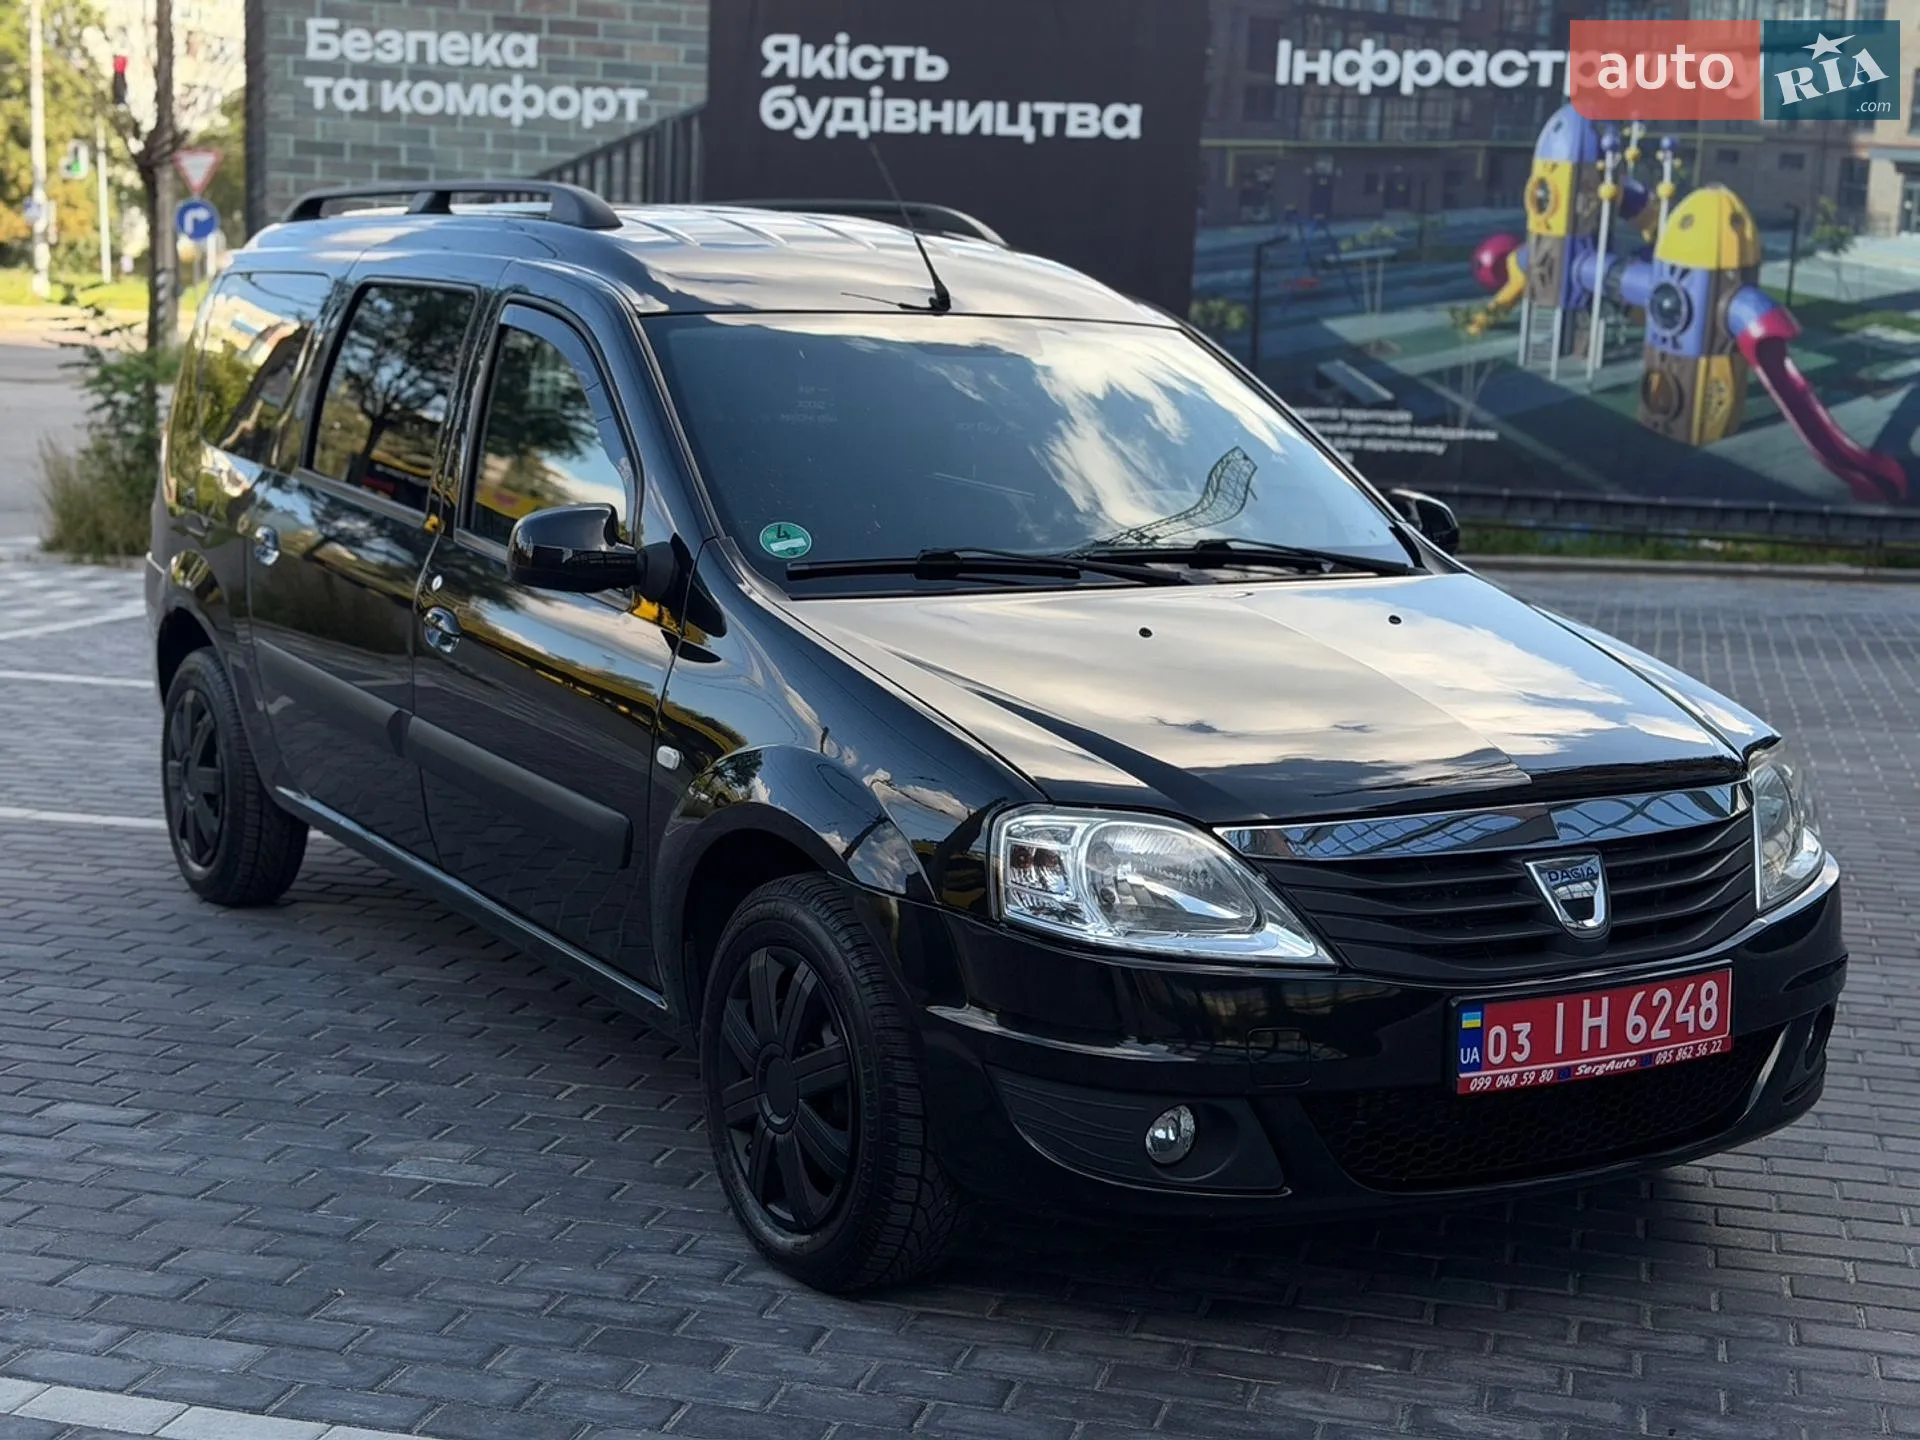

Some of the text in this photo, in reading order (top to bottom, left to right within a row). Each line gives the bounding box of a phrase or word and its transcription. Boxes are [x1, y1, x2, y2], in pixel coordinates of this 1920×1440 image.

[305, 17, 539, 68] Безпека
[760, 32, 950, 82] Якість
[303, 74, 649, 129] та комфорт
[759, 84, 1143, 144] будівництва
[1547, 865, 1598, 882] DACIA
[1486, 1021, 1532, 1065] 03
[1625, 980, 1719, 1045] 6248
[1460, 1047, 1480, 1065] UA
[1575, 1057, 1637, 1076] SergAuto
[1675, 1046, 1694, 1062] 862
[1469, 1076, 1492, 1092] 099
[1520, 1071, 1536, 1086] 59
[1539, 1069, 1555, 1084] 80
